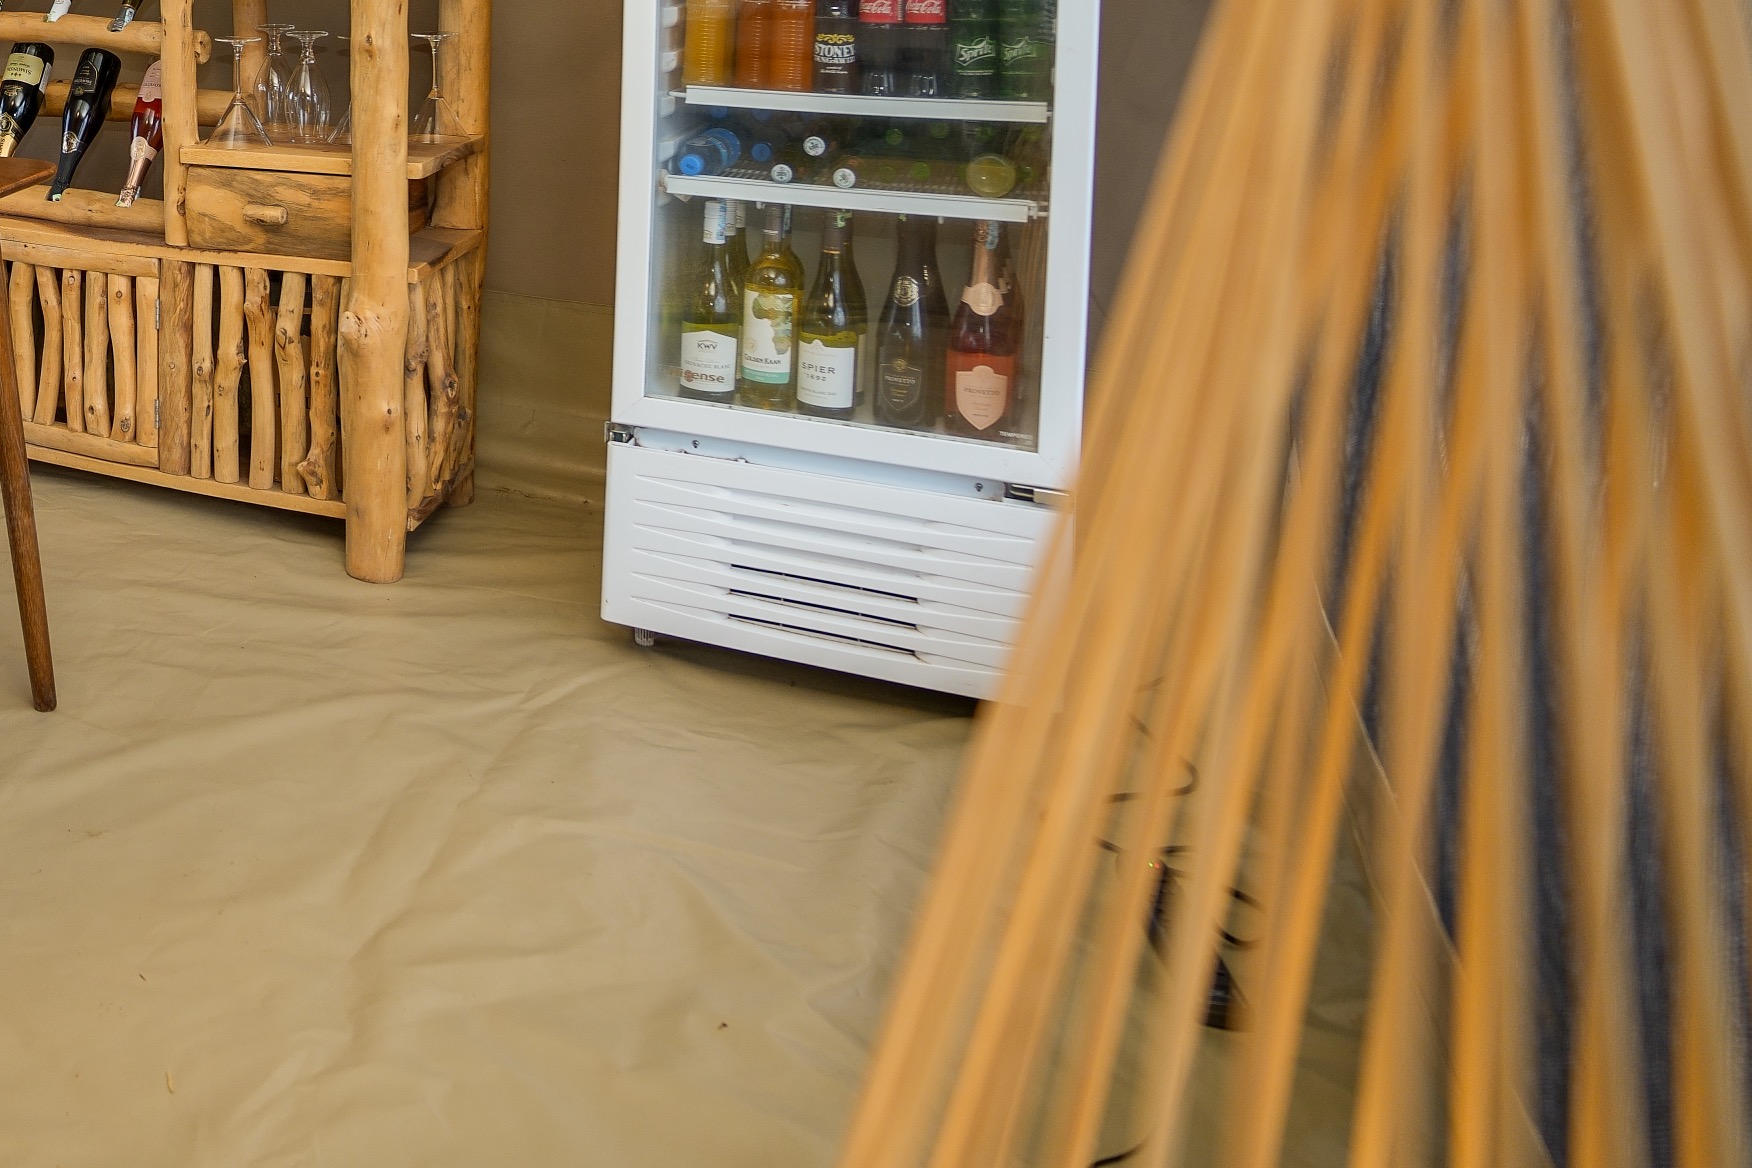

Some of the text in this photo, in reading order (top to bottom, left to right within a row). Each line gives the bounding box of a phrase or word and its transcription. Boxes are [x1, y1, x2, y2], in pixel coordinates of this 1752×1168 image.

[906, 0, 943, 15] Coca-Cola
[814, 43, 855, 58] STONEY
[697, 342, 718, 350] KWV
[801, 361, 836, 375] SPIER
